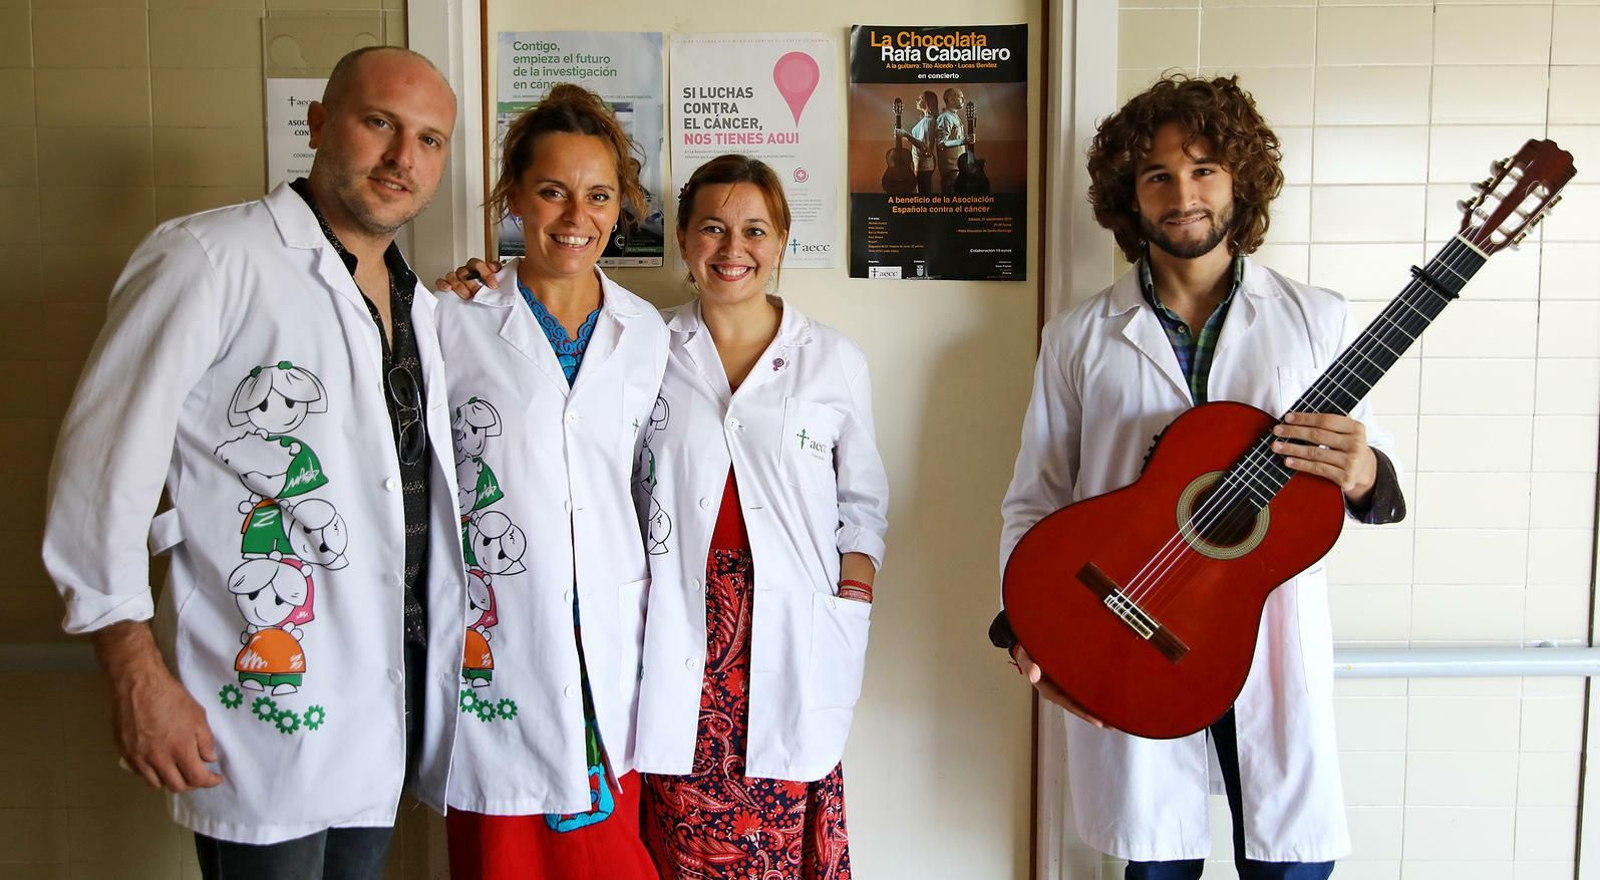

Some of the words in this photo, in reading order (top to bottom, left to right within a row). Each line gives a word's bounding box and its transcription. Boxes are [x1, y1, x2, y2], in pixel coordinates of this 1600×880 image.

[870, 31, 893, 47] La
[896, 31, 987, 48] Chocolata
[513, 41, 561, 53] Contigo,
[513, 54, 560, 66] empieza
[563, 53, 573, 64] el
[576, 53, 611, 64] futuro
[881, 45, 921, 62] Rafa
[925, 45, 1011, 62] Caballero
[513, 67, 528, 77] de
[530, 67, 540, 77] la
[543, 66, 617, 78] investigación
[513, 81, 527, 89] en
[683, 87, 696, 99] SI
[699, 87, 754, 99] LUCHAS
[683, 102, 739, 114] CONTRA
[684, 118, 701, 129] EL
[704, 114, 763, 131] CÁNCER,
[684, 133, 712, 145] NOS
[715, 132, 764, 145] TIENES
[895, 196, 931, 204] beneficio
[892, 206, 928, 214] Española
[802, 243, 831, 252] aecc
